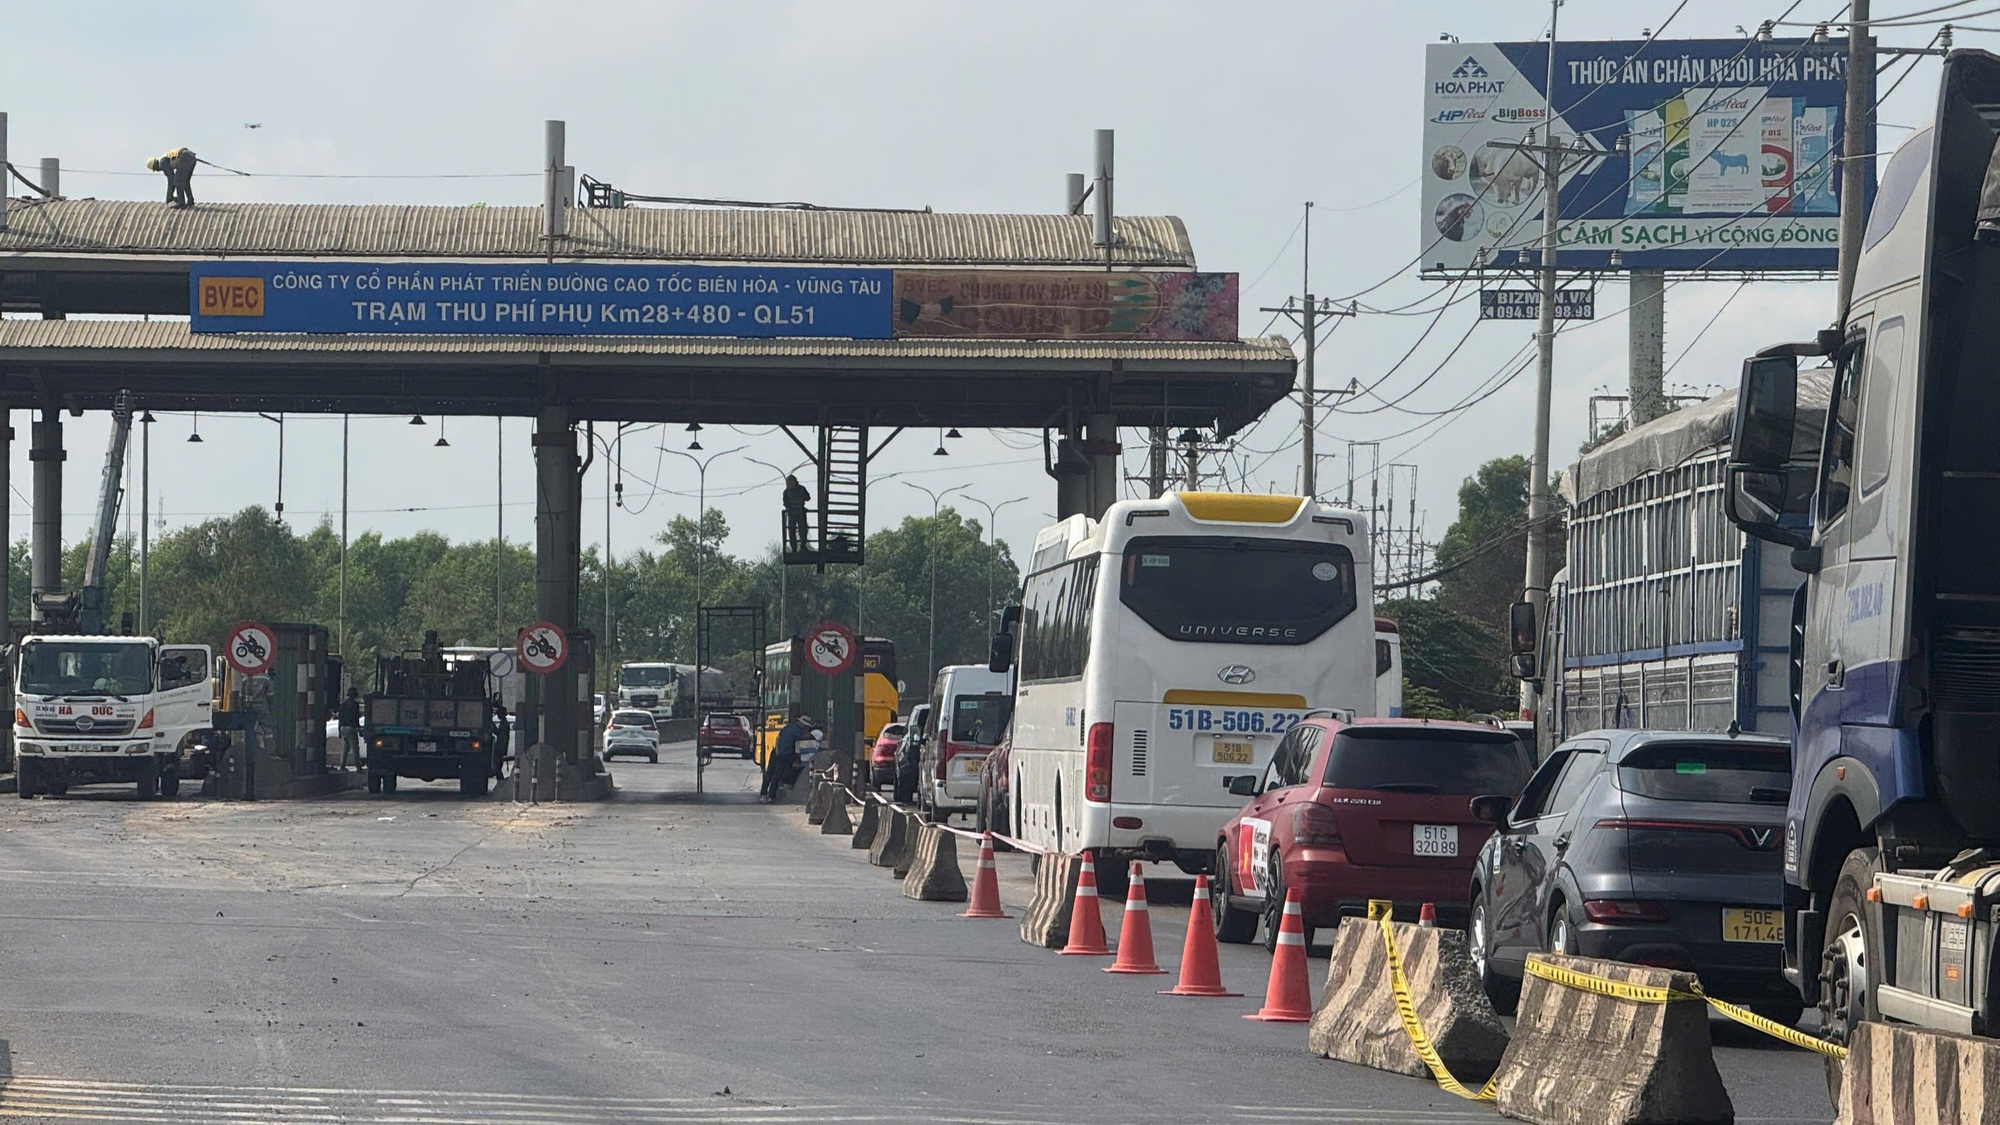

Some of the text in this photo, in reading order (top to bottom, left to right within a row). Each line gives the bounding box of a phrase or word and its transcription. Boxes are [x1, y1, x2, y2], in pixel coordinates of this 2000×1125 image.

[1568, 56, 1617, 84] THỨC
[1622, 55, 1649, 84] ĂN
[1653, 55, 1705, 83] CHĂN
[1760, 56, 1798, 82] HÒA
[1499, 108, 1545, 120] BigBoss
[1557, 220, 1838, 251] CÁM SẠCH VÌ CỘNG ĐỒNG
[273, 272, 322, 289] CÔNG
[328, 275, 348, 289] TY
[356, 268, 380, 290] CỔ
[387, 270, 433, 291] PHẦN
[440, 272, 485, 291] PHÁT
[492, 270, 543, 292] TRIỂN
[548, 272, 608, 292] ĐƯỜNG
[614, 277, 649, 292] CAO
[657, 272, 692, 293] TỐC
[698, 275, 737, 293] BIÊN
[743, 275, 778, 293] HÒA
[797, 275, 843, 294] VŨNG
[849, 276, 881, 294] TÀU
[904, 279, 948, 293] BVEC
[205, 285, 259, 308] BVEC
[1497, 292, 1591, 304] BIZMN.VN
[352, 302, 426, 326] TRẠM
[436, 303, 486, 321] THU
[495, 299, 535, 322] PHÍ
[541, 304, 592, 328] PHỤ
[601, 305, 730, 323] Km28+480
[754, 306, 815, 324] QL51
[1180, 625, 1296, 638] UNIVERSE
[864, 659, 876, 668] NG
[59, 704, 113, 715] HÀ ĐỨC
[1169, 709, 1299, 733] 51B-506.22
[1224, 744, 1241, 752] 51B
[1218, 753, 1248, 762] 506.22
[1425, 827, 1447, 840] 51G
[1416, 841, 1456, 853] 320.89
[1744, 911, 1772, 924] 50E
